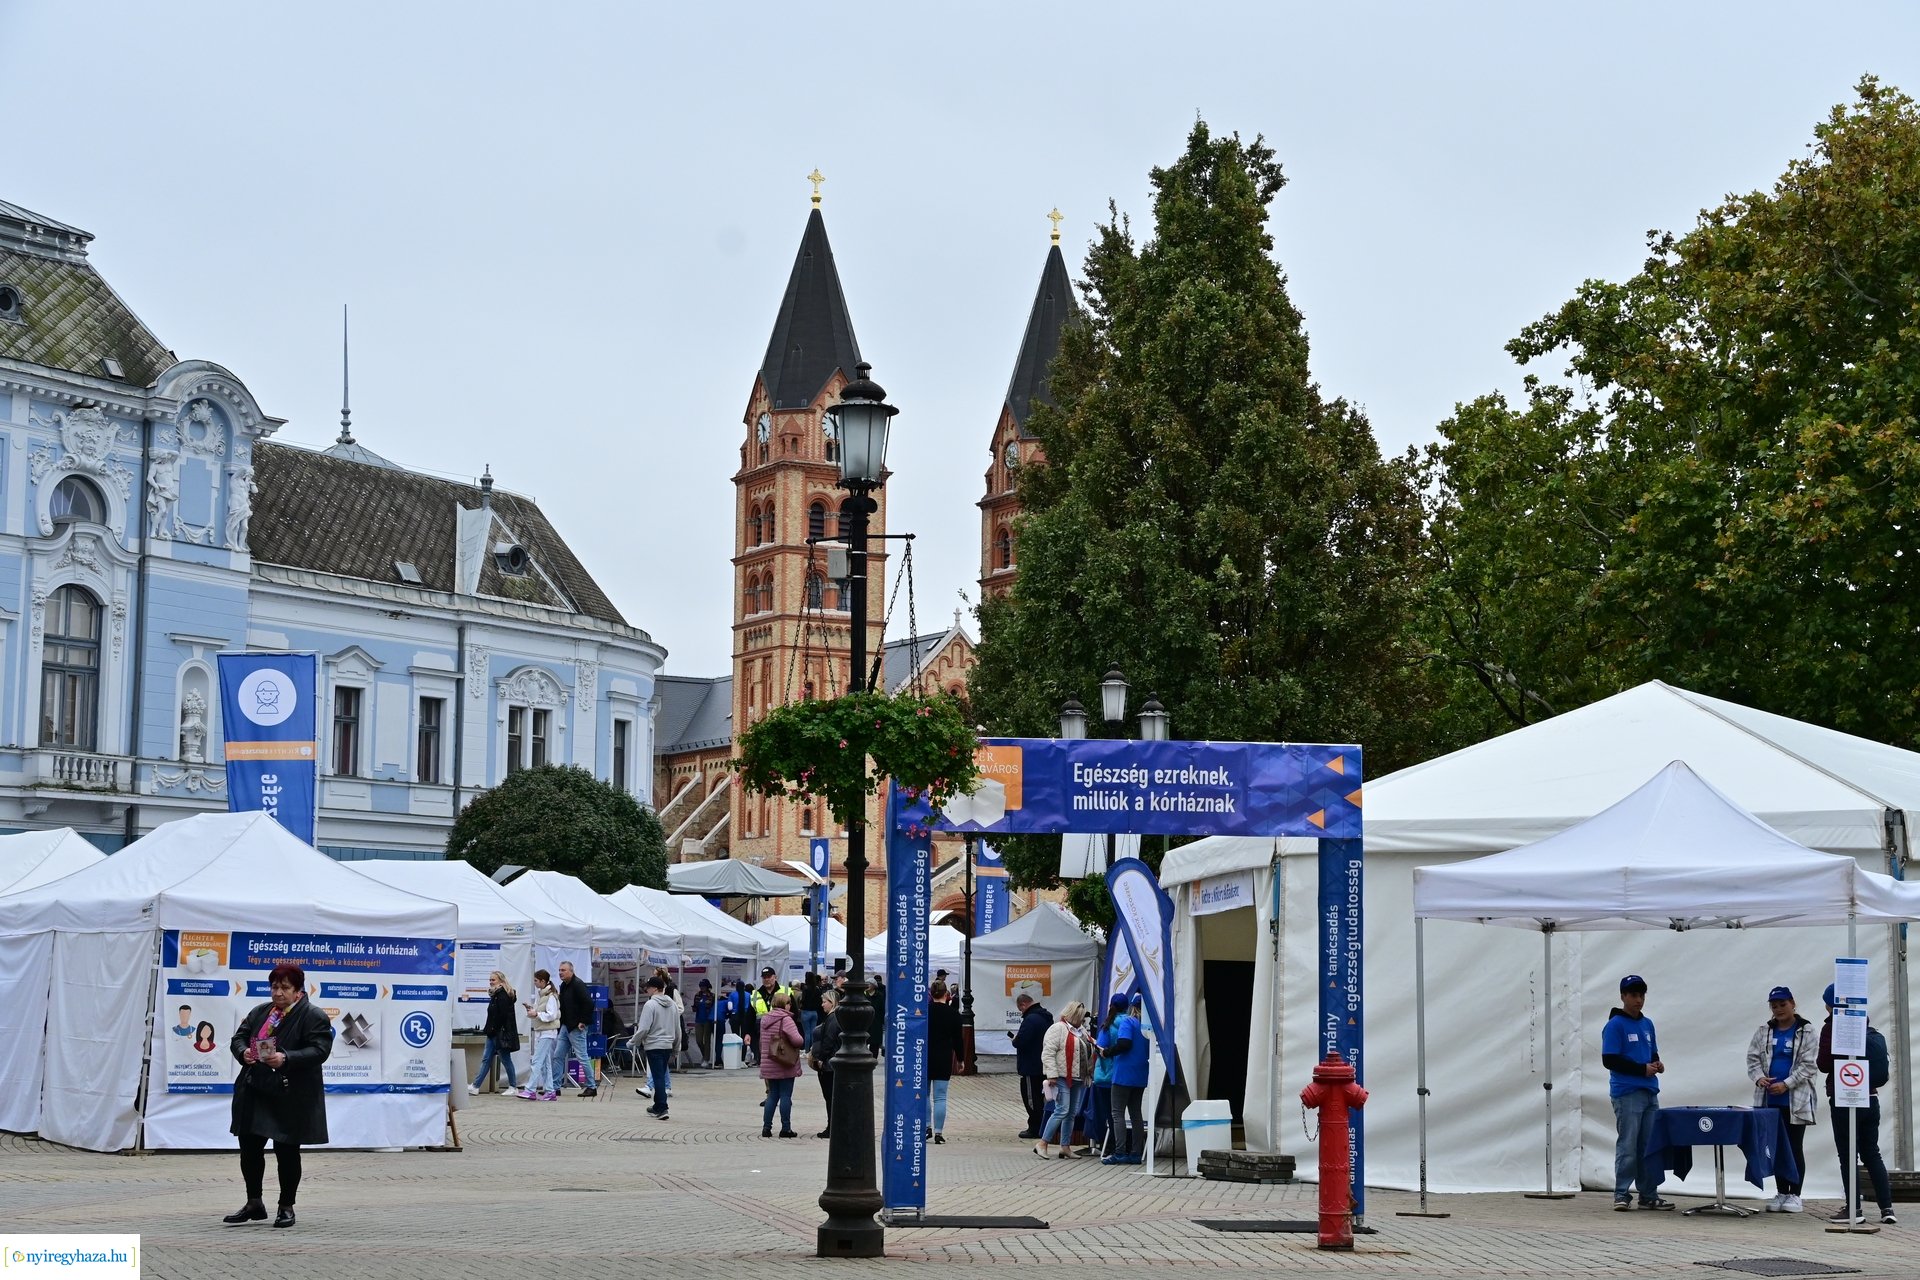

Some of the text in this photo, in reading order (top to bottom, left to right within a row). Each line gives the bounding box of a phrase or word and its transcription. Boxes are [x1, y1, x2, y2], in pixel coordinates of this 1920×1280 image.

[978, 763, 1019, 774] GVÁROS
[1073, 762, 1234, 789] Egészség ezreknek,
[1073, 790, 1235, 813] milliók a kórháznak
[896, 894, 908, 967] tanácsadás
[912, 849, 928, 1003] egészségtudatosság
[1325, 904, 1339, 977] tanácsadás
[1343, 859, 1362, 1012] egészségtudatosság
[247, 955, 261, 965] Tégy
[272, 956, 310, 966] egészségért,
[312, 957, 336, 967] tegyünk
[343, 958, 381, 969] közösségért!
[248, 939, 419, 956] Egészség ezreknek, milliók a kórháznak
[410, 1020, 428, 1040] RG
[892, 1004, 909, 1074] adomány
[1322, 1012, 1340, 1054] mány
[913, 1038, 925, 1090] közösség
[892, 1113, 904, 1151] szűrés
[911, 1118, 923, 1177] támogatás
